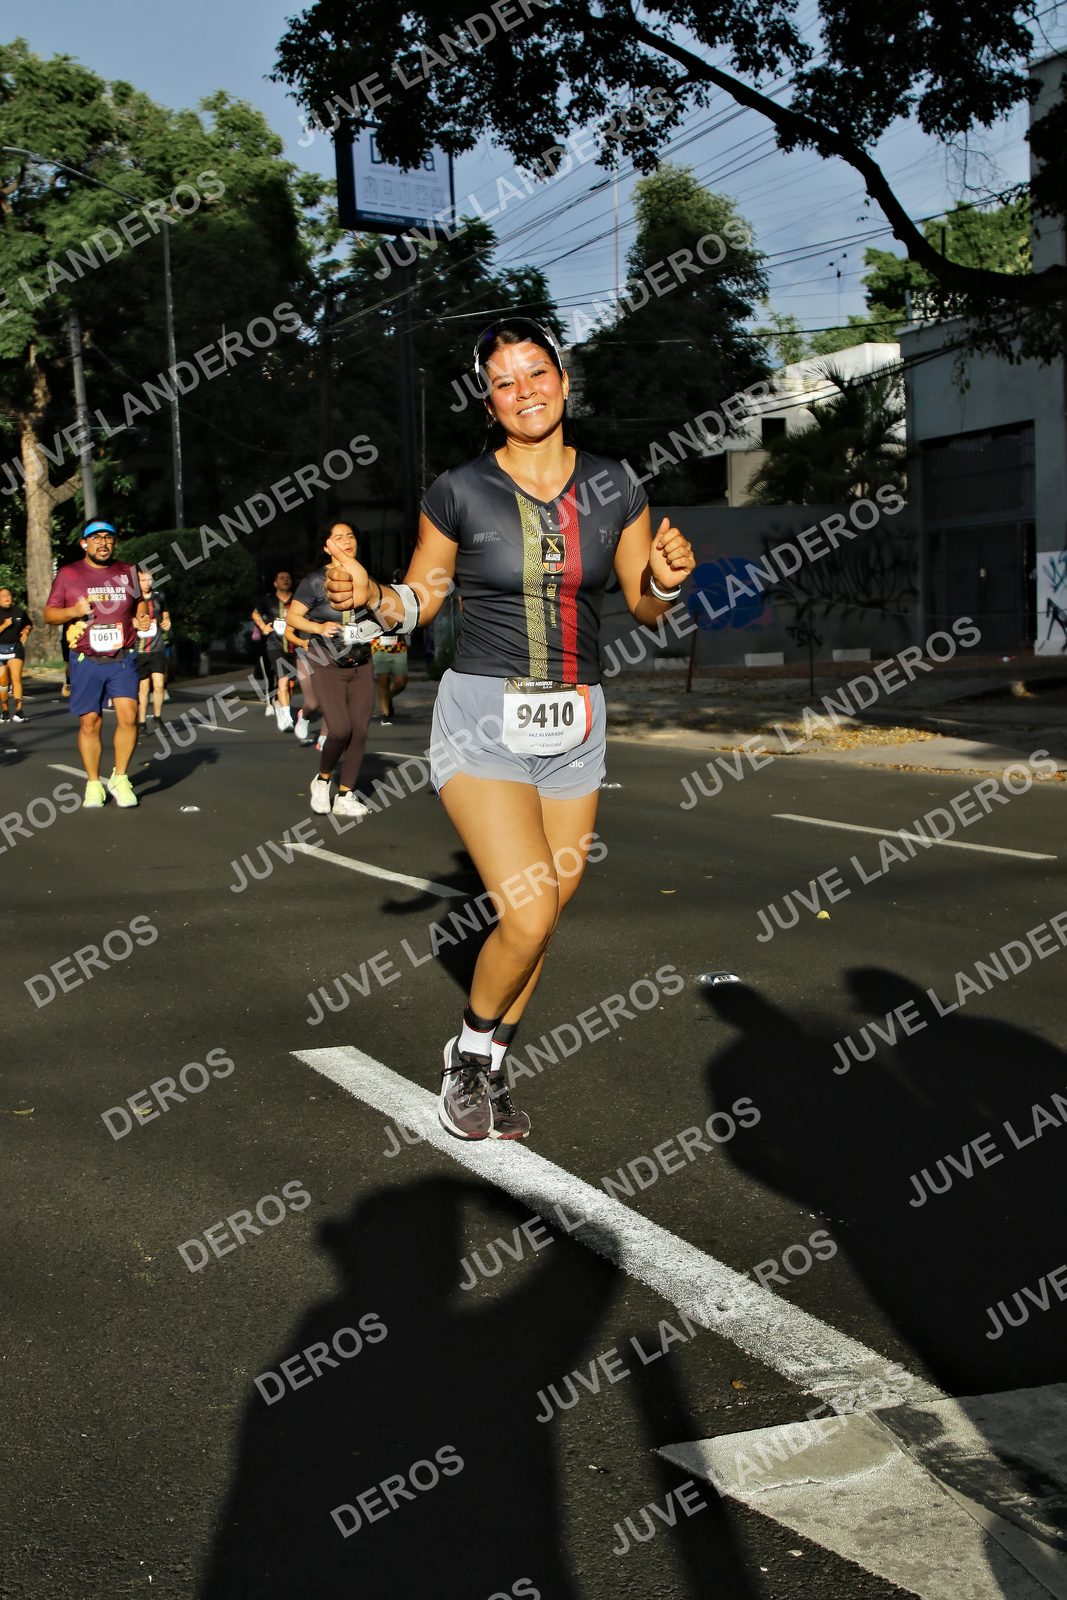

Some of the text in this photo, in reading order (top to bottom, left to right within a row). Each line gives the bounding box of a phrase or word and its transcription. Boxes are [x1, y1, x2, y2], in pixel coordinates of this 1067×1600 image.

[87, 586, 115, 594] CARRERA
[93, 631, 119, 642] 10611
[516, 701, 574, 729] 9410
[539, 730, 565, 738] ALVARADO
[568, 759, 584, 768] alo
